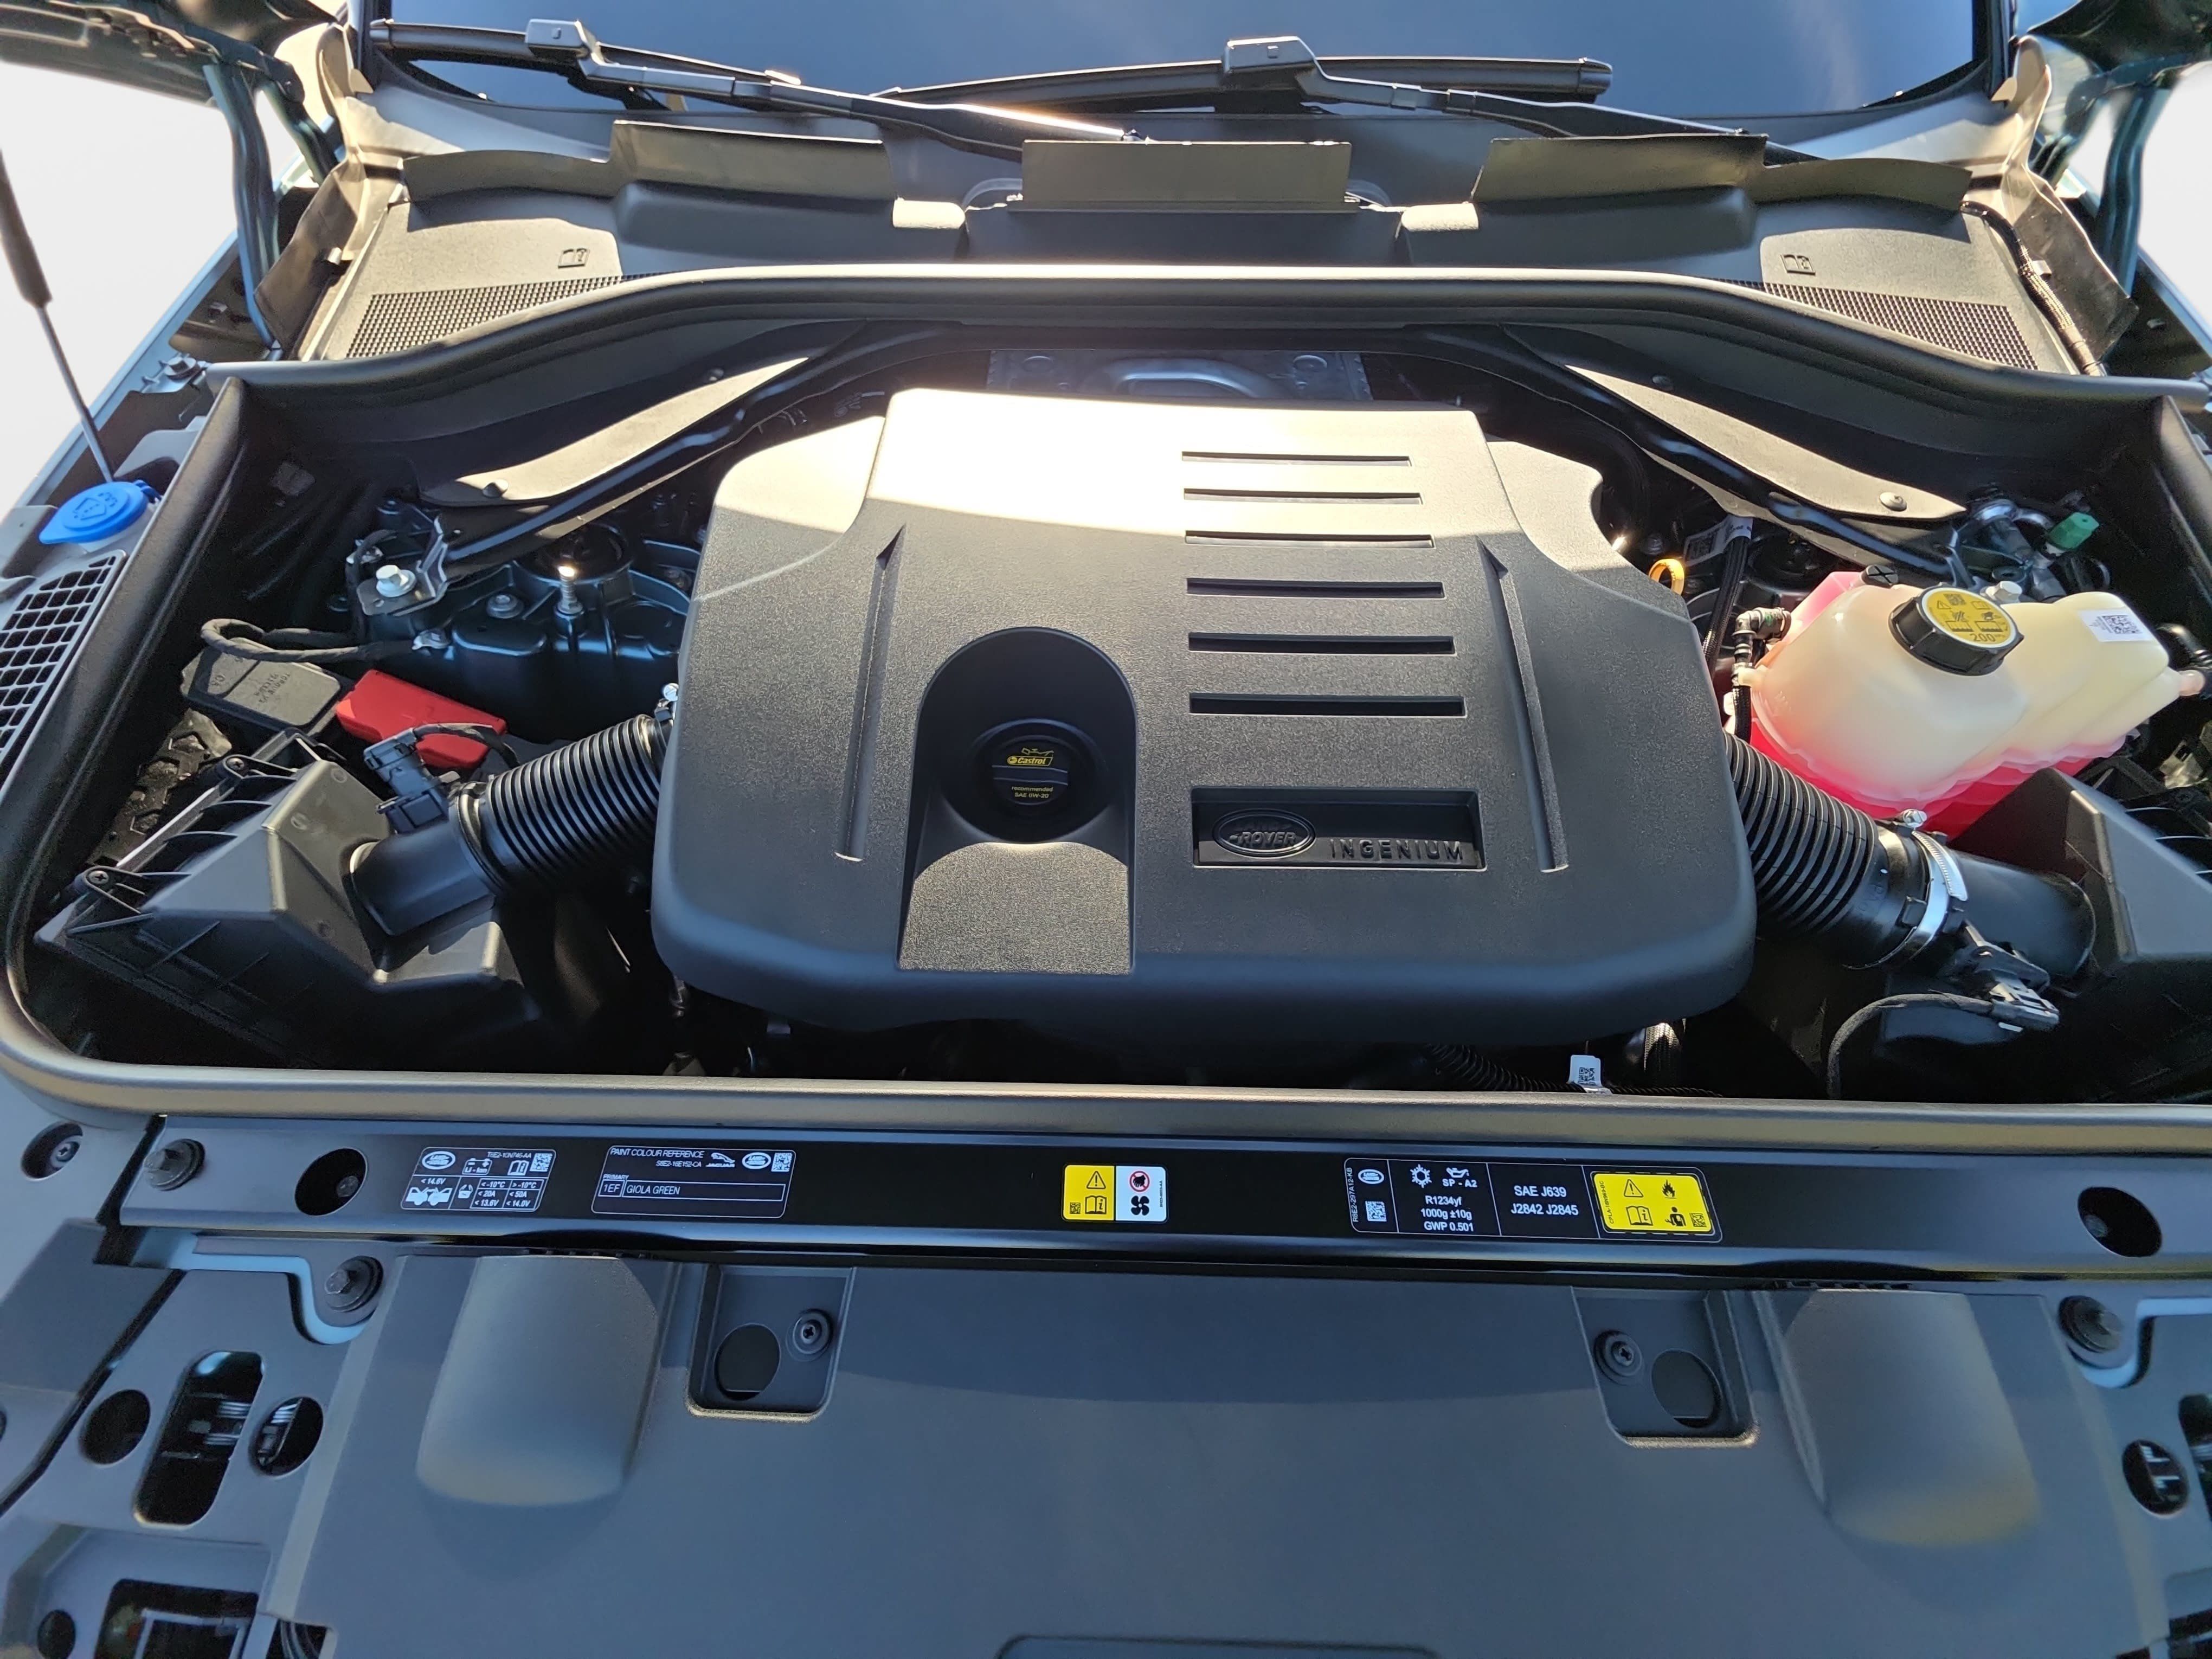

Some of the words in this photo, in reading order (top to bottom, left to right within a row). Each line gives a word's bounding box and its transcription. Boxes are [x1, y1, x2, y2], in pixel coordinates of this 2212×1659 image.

[1969, 633, 1996, 642] 200
[1239, 831, 1296, 846] ROVER
[1329, 838, 1463, 861] INGENIUM
[663, 1150, 705, 1158] REFERENCE
[603, 1184, 621, 1193] 1EF
[1442, 1178, 1456, 1187] SP
[1464, 1179, 1478, 1188] A2
[626, 1185, 651, 1194] GIOLA
[652, 1186, 680, 1195] GREEN
[1513, 1185, 1539, 1197] SAE
[1540, 1186, 1567, 1198] J639
[512, 1199, 531, 1207] 14.0V
[1425, 1195, 1462, 1207] R1234yf
[1420, 1208, 1449, 1220] 1000g
[1449, 1209, 1472, 1221] ±10g
[1510, 1203, 1545, 1215] J2842
[1546, 1204, 1579, 1216] J2845
[1424, 1221, 1448, 1231] GWP
[1449, 1221, 1474, 1232] 0.501
